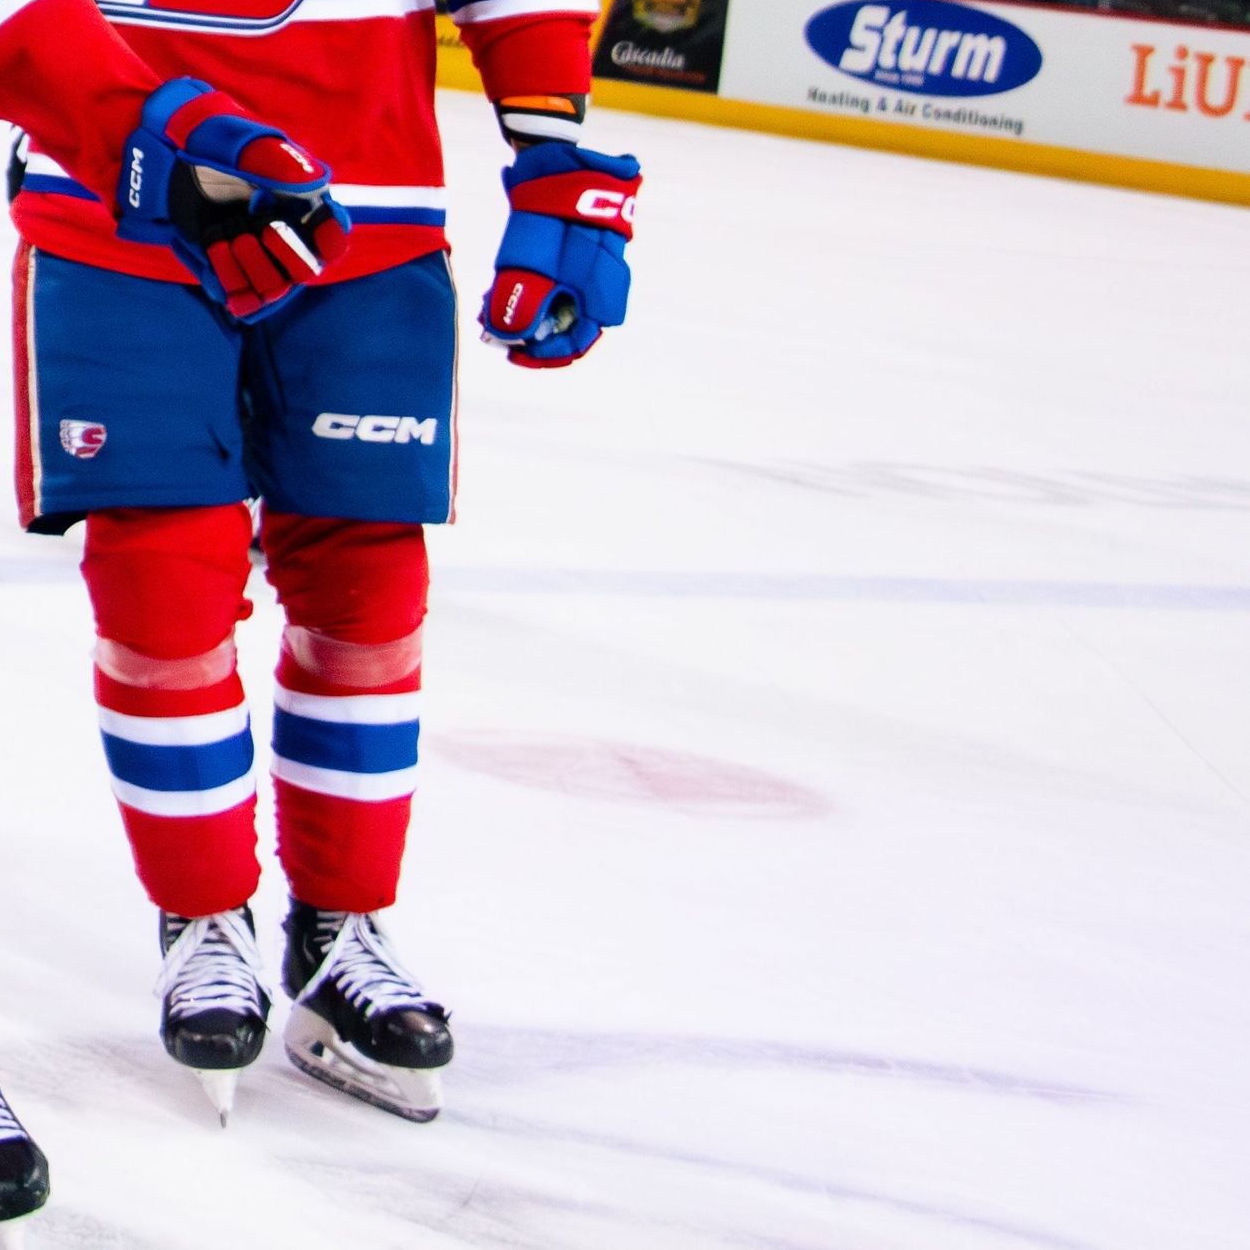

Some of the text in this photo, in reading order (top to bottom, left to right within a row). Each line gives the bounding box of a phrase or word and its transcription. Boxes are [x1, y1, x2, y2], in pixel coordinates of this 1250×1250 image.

[838, 4, 1008, 84] Sturm
[807, 86, 1024, 134] Heating & Air Conditioning
[128, 147, 145, 209] CCM
[503, 283, 524, 326] CCM
[312, 412, 438, 445] CCM
